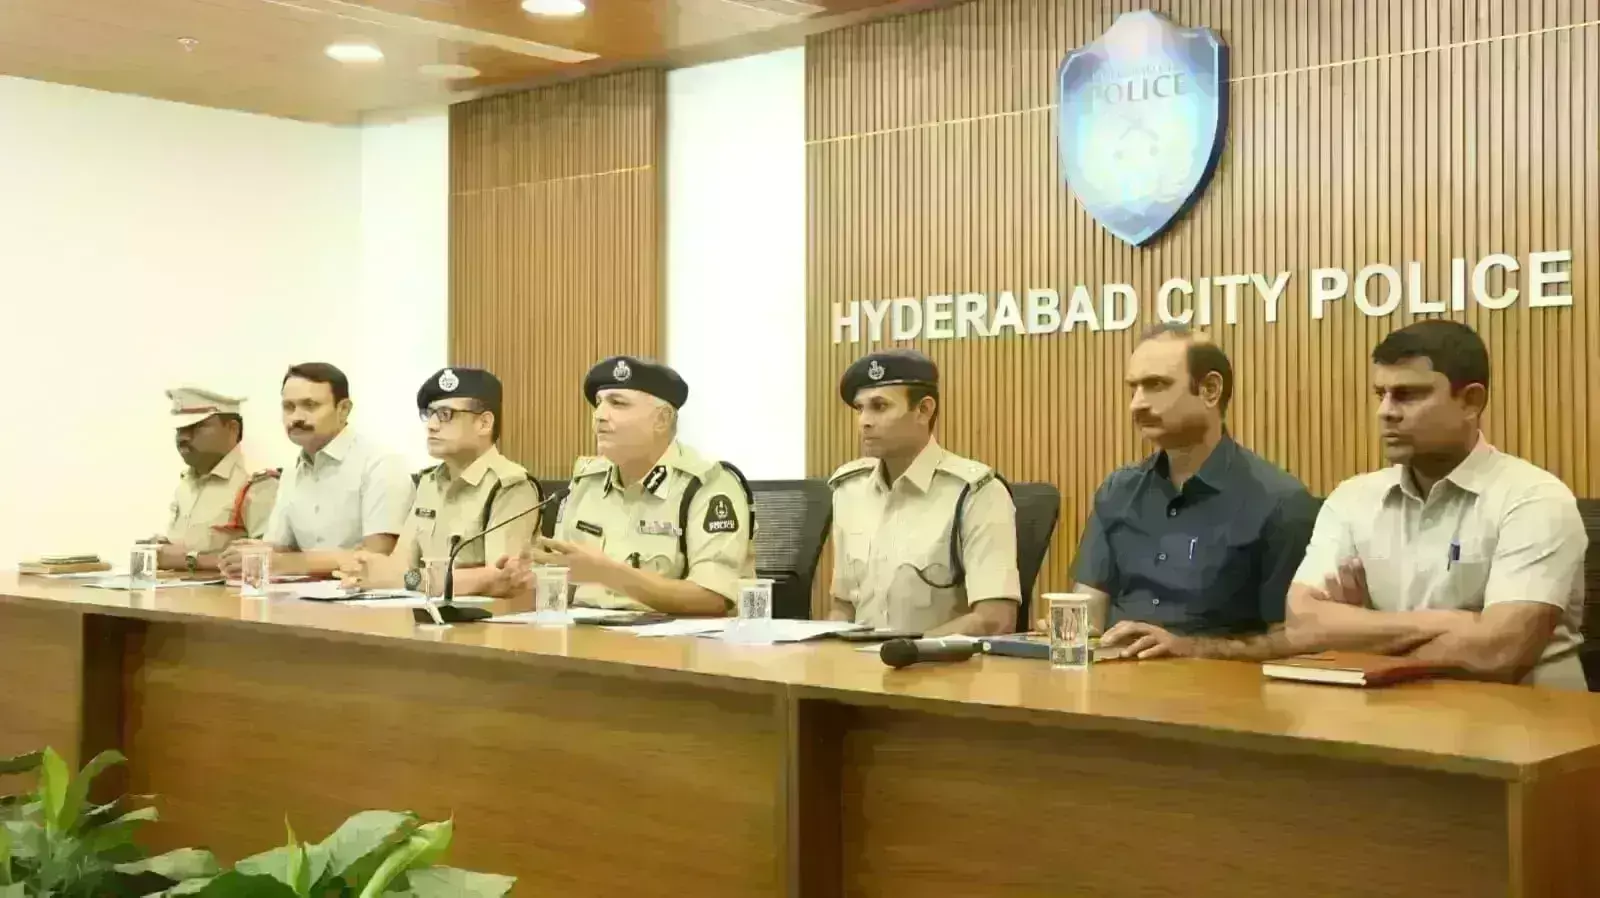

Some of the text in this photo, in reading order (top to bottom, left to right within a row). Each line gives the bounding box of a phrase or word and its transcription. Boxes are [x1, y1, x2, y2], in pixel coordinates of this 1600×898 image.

[833, 250, 1573, 344] HYDERABAD CITY POLICE
